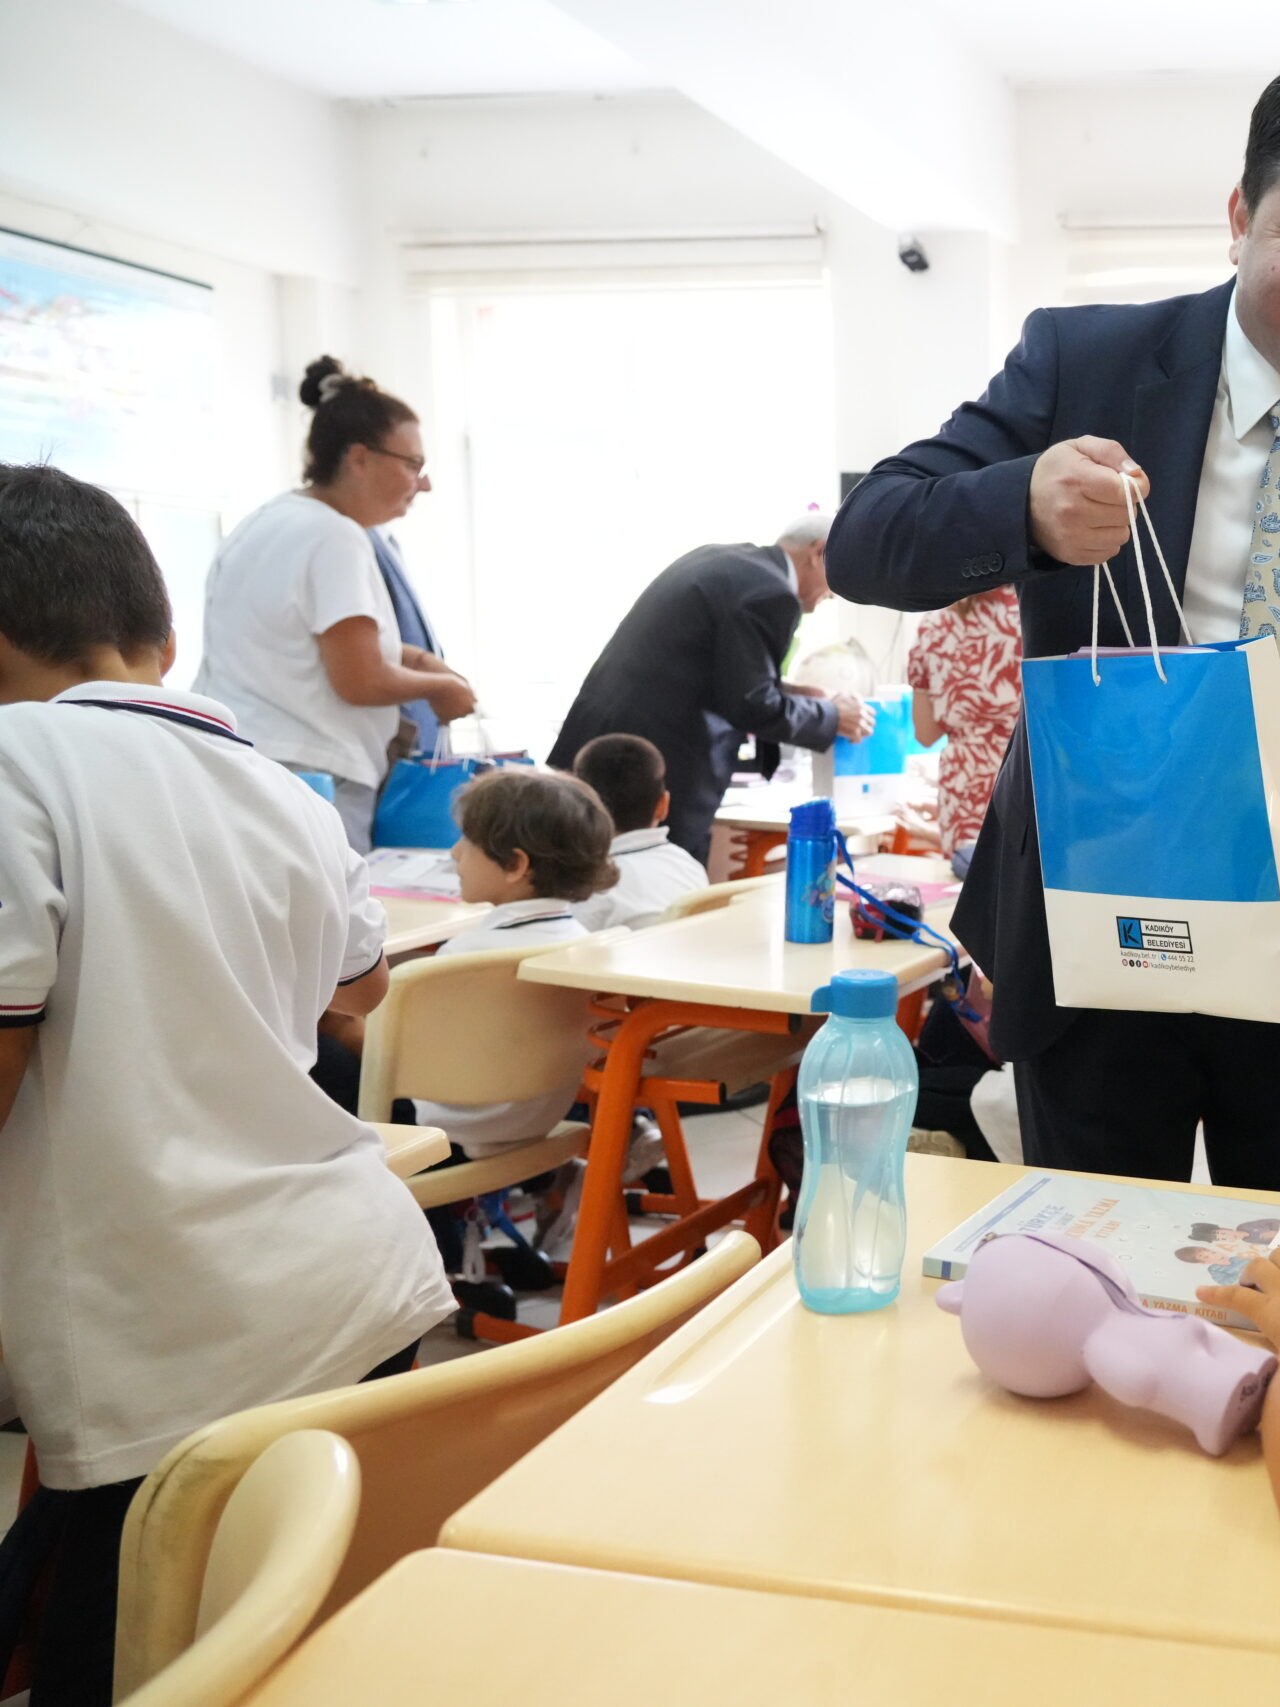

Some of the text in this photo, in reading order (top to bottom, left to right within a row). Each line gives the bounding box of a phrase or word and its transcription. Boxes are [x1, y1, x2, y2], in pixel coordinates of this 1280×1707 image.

[1122, 922, 1139, 944] K
[1145, 924, 1174, 934] KADIKÖY
[1147, 939, 1186, 949] BELEDİYESİ
[1153, 1301, 1188, 1314] YAZMA
